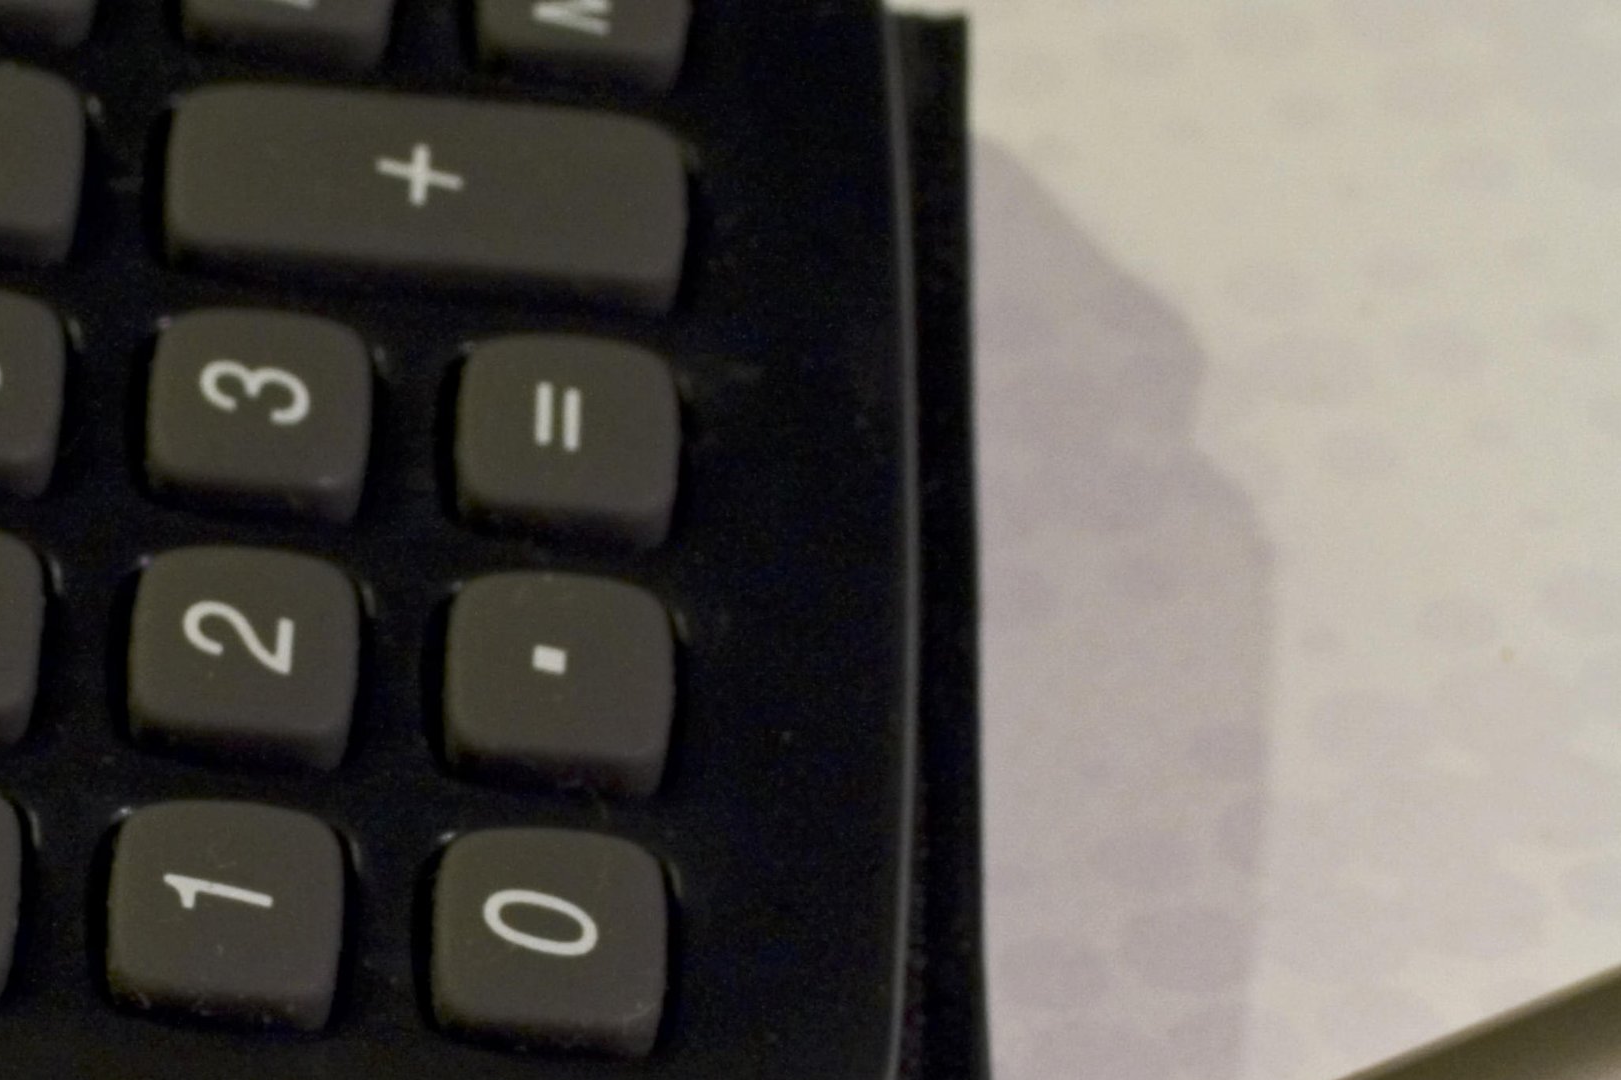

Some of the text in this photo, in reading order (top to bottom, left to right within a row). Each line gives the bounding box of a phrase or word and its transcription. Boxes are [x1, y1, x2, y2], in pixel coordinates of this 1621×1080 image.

[198, 360, 311, 425] 3
[182, 600, 295, 675] 2
[162, 872, 274, 910] 1
[482, 888, 599, 957] 0
